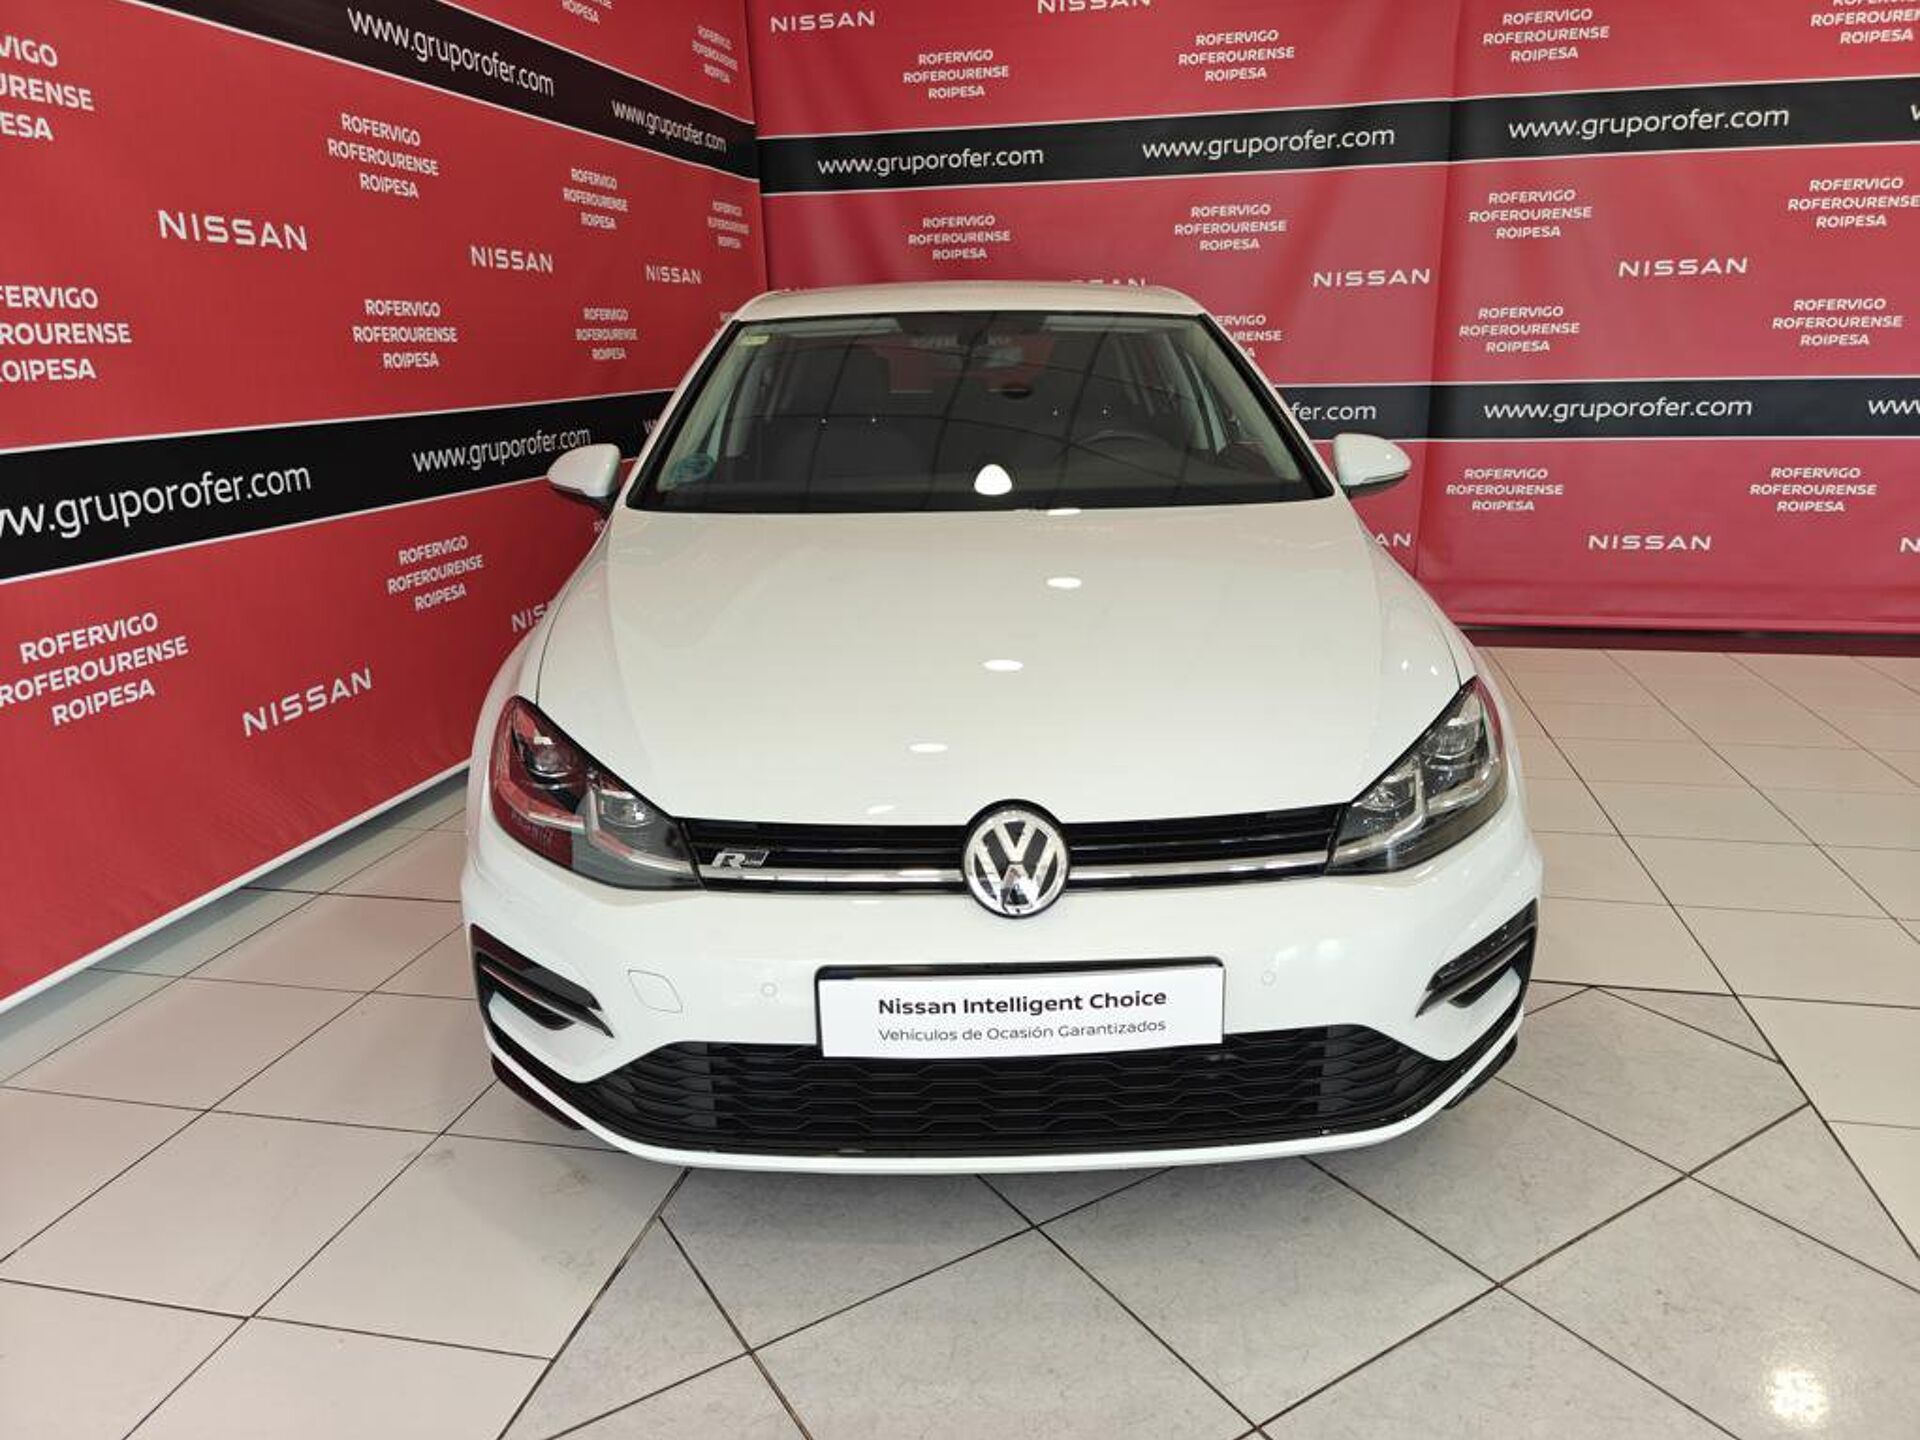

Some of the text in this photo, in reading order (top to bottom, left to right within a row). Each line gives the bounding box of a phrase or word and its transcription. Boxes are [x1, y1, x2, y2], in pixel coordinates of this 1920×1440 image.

[771, 11, 875, 32] NISSAN
[1503, 8, 1593, 25] ROFERVIGO
[1196, 30, 1279, 46] ROFERVIGO
[1483, 26, 1609, 44] ROFEROURENSE
[1840, 28, 1913, 44] ROIPESA
[347, 8, 553, 96] www.gruporofer.com
[919, 49, 993, 65] ROFERVIGO
[1179, 47, 1294, 65] ROFEROURENSE
[1511, 47, 1578, 62] ROIPESA
[903, 65, 1009, 83] ROFEROURENSE
[1205, 67, 1267, 81] ROIPESA
[928, 85, 985, 98] ROIPESA
[341, 113, 420, 146] ROFERVIGO
[612, 100, 726, 152] www.gruporofer.com
[1509, 108, 1789, 140] www.gruporofer.com
[1143, 129, 1394, 160] www.gruporofer.com
[327, 138, 439, 175] ROFEROURENSE
[817, 148, 1044, 176] www.gruporofer.com
[359, 173, 418, 197] ROIPESA
[1809, 177, 1904, 191] ROFERVIGO
[1489, 189, 1576, 204] ROFERVIGO
[1788, 195, 1920, 210] ROFEROURENSE
[1191, 204, 1271, 217] ROFERVIGO
[1469, 207, 1592, 222] ROFEROURENSE
[923, 215, 995, 228] ROFERVIGO
[1175, 220, 1286, 235] ROFEROURENSE
[1816, 215, 1886, 228] ROIPESA
[158, 210, 307, 250] NISSAN
[908, 230, 1011, 245] ROFEROURENSE
[1496, 226, 1561, 239] ROIPESA
[1200, 238, 1259, 250] ROIPESA
[471, 246, 552, 272] NISSAN
[933, 248, 987, 259] ROIPESA
[646, 265, 701, 284] NISSAN
[1619, 258, 1747, 277] NISSAN
[1314, 269, 1429, 287] NISSAN
[0, 285, 98, 308] ERVIGO
[1794, 298, 1886, 310] ROFERVIGO
[365, 299, 440, 317] ROFERVIGO
[1478, 306, 1563, 319] ROFERVIGO
[1459, 323, 1580, 336] ROFEROURENSE
[1773, 316, 1902, 329] ROFEROURENSE
[353, 326, 457, 342] ROFEROURENSE
[1800, 334, 1869, 346] ROIPESA
[1486, 340, 1550, 352] ROIPESA
[383, 352, 439, 368] ROIPESA
[0, 359, 96, 382] OIPESA
[1484, 397, 1752, 423] www.gruporofer.com
[412, 427, 591, 471] www.gruporofer.com
[1465, 468, 1548, 479] ROFERVIGO
[1771, 467, 1861, 478] ROFERVIGO
[1446, 484, 1563, 495] ROFEROURENSE
[1750, 484, 1877, 495] ROFEROURENSE
[1472, 500, 1534, 511] ROIPESA
[1777, 501, 1845, 512] ROIPESA
[399, 536, 468, 565] ROFERVIGO
[1589, 535, 1711, 550] NISSAN
[387, 554, 483, 594] ROFEROURENSE
[415, 583, 466, 610] ROIPESA
[20, 613, 157, 663] ROFERVIGO
[0, 636, 188, 707] ROFEROURENSE
[52, 679, 155, 725] ROIPESA
[243, 669, 371, 736] NISSAN
[879, 991, 1166, 1016] Nissan Intelligent Choice
[962, 1029, 982, 1040] de
[987, 1026, 1053, 1040] Ocasión
[1058, 1021, 1166, 1037] Garantizados
